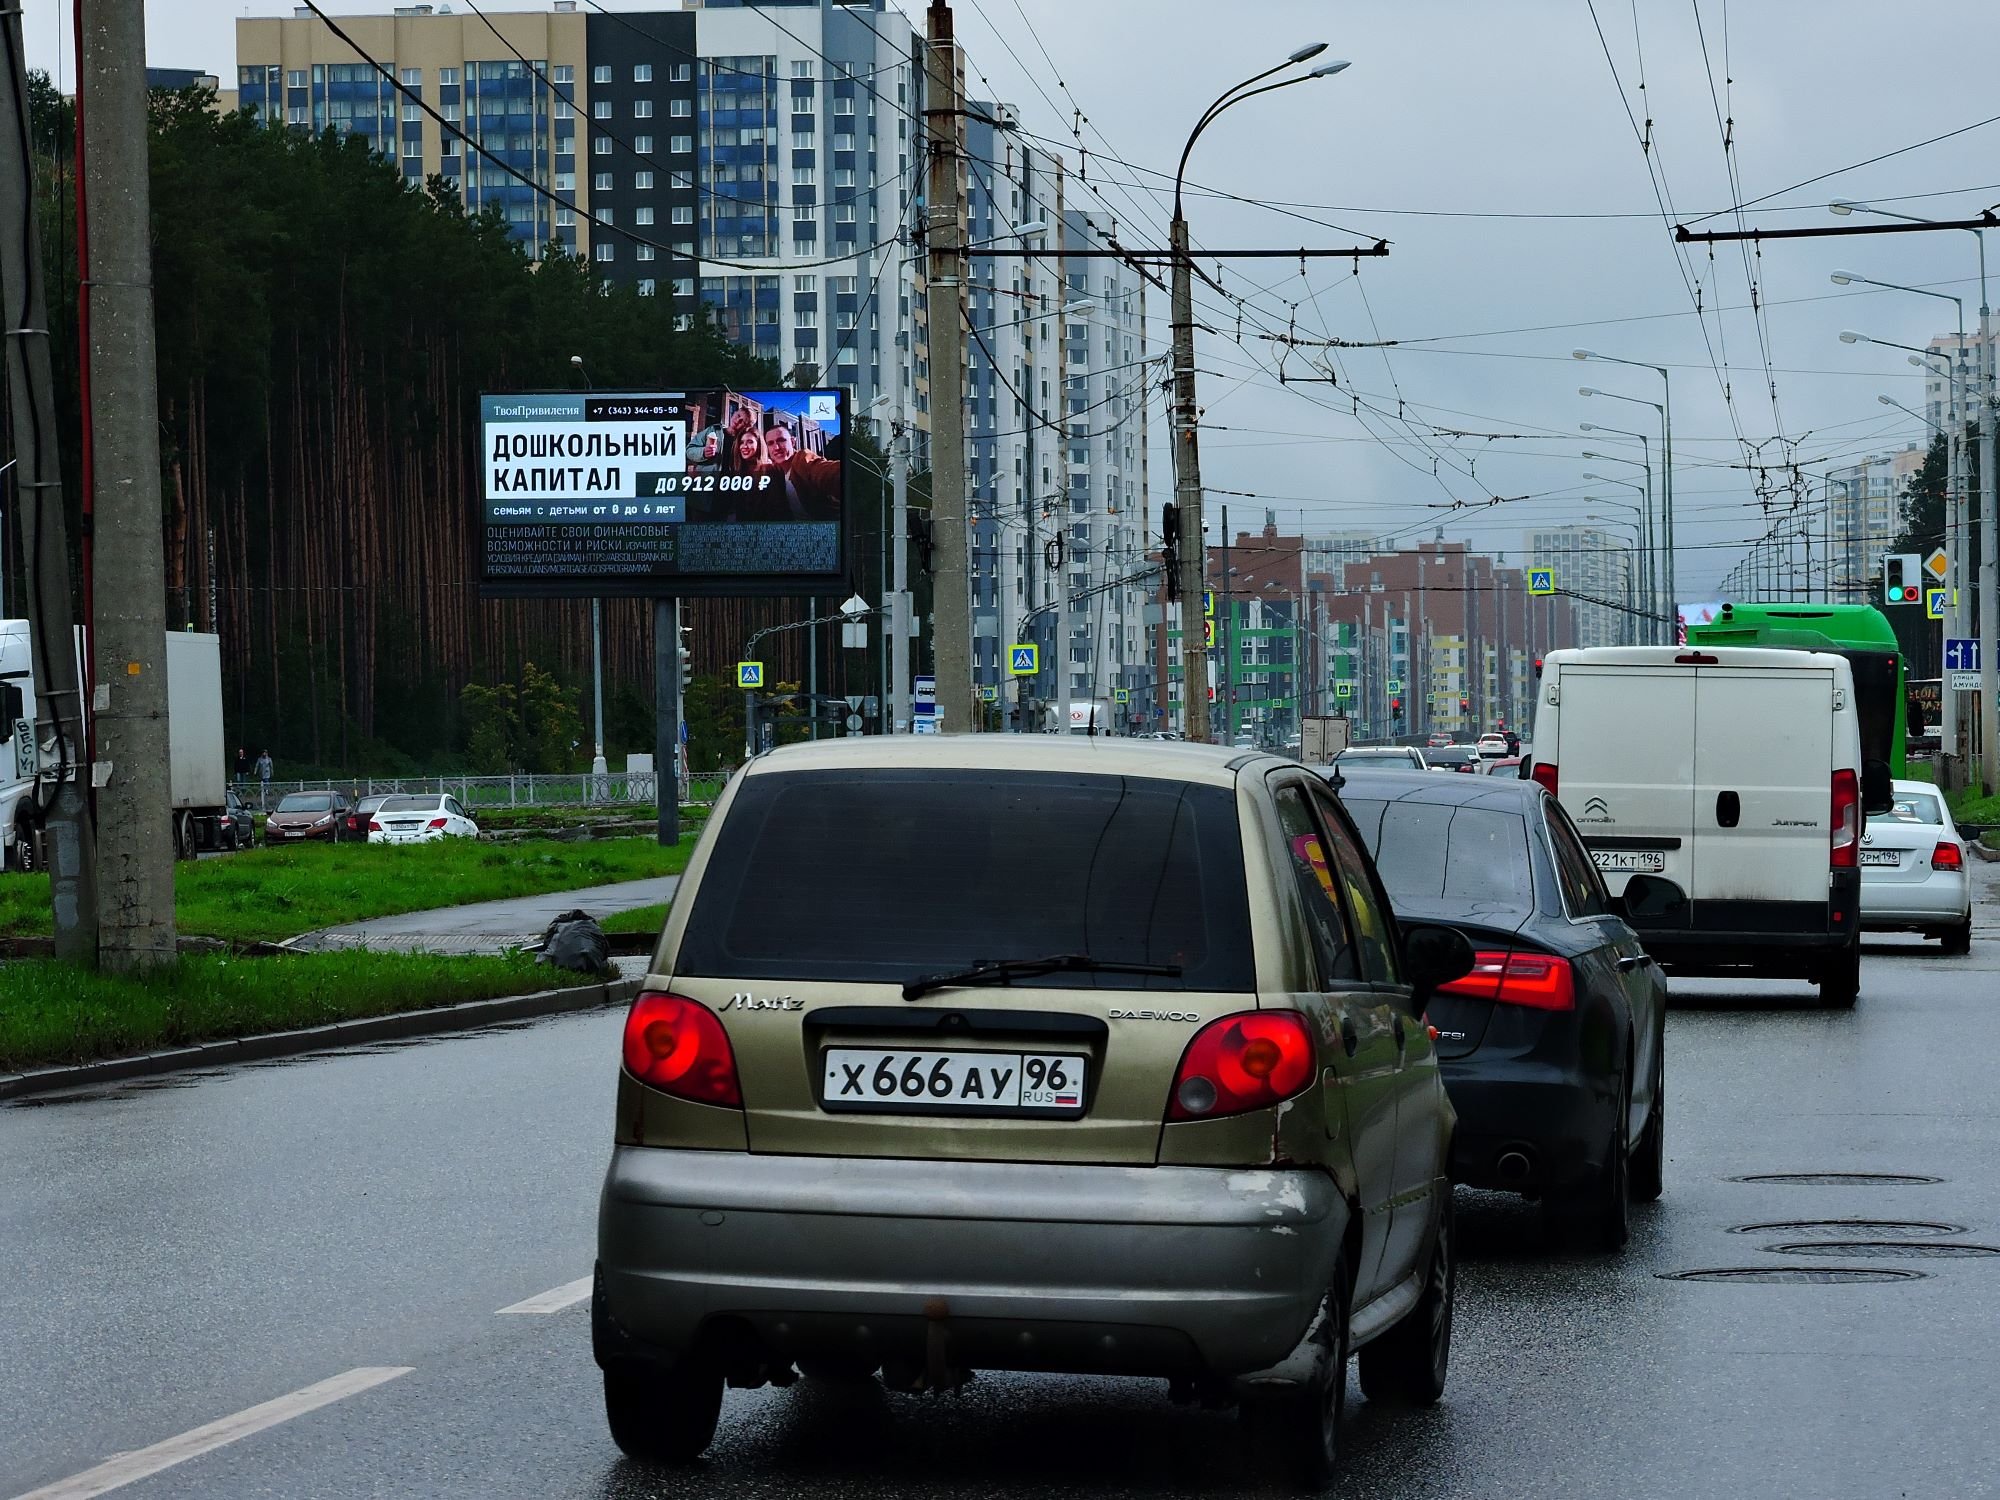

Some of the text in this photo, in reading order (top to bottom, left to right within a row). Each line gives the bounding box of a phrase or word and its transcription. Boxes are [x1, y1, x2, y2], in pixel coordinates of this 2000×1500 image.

[494, 405, 580, 418] ТвояПривилегия
[593, 406, 679, 415] +7 (343) 344-05-50
[493, 426, 676, 462] ДОШКОЛЬНЫЙ
[494, 467, 621, 491] КАПИТАЛ
[681, 475, 715, 492] 912
[719, 475, 753, 491] 000
[493, 504, 676, 516] семьям с детьми от 0 до 6 лет
[487, 525, 670, 539] ОЦЕНИВАЙТЕ СВОИ ФИНАНСОВЫЕ
[487, 540, 571, 552] ВОЗМОЖНОСТИ
[575, 540, 582, 551] И
[625, 541, 657, 551] ИЗУЧИТЕ
[660, 541, 674, 550] ВСЕ
[1640, 853, 1661, 864] 196
[1881, 851, 1897, 860] 196
[718, 992, 806, 1013] Matiz
[1108, 1008, 1201, 1023] DAEWOO
[1025, 1058, 1068, 1091] 96
[1023, 1090, 1054, 1103] RUS
